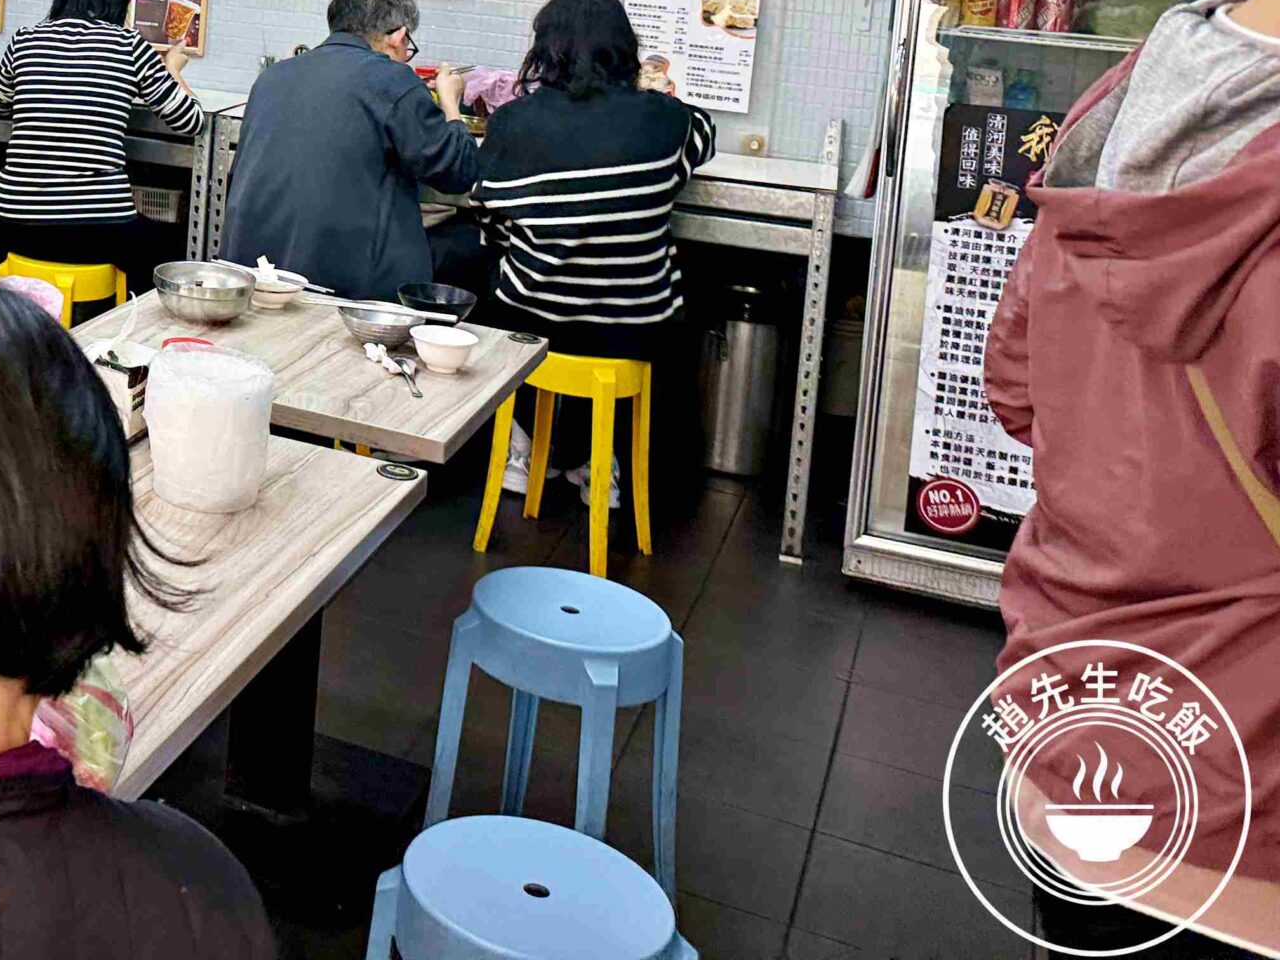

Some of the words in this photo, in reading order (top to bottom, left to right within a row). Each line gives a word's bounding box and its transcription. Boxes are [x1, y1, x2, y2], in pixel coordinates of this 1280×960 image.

[959, 127, 979, 188] 值得回味
[984, 114, 1005, 174] 清河美味
